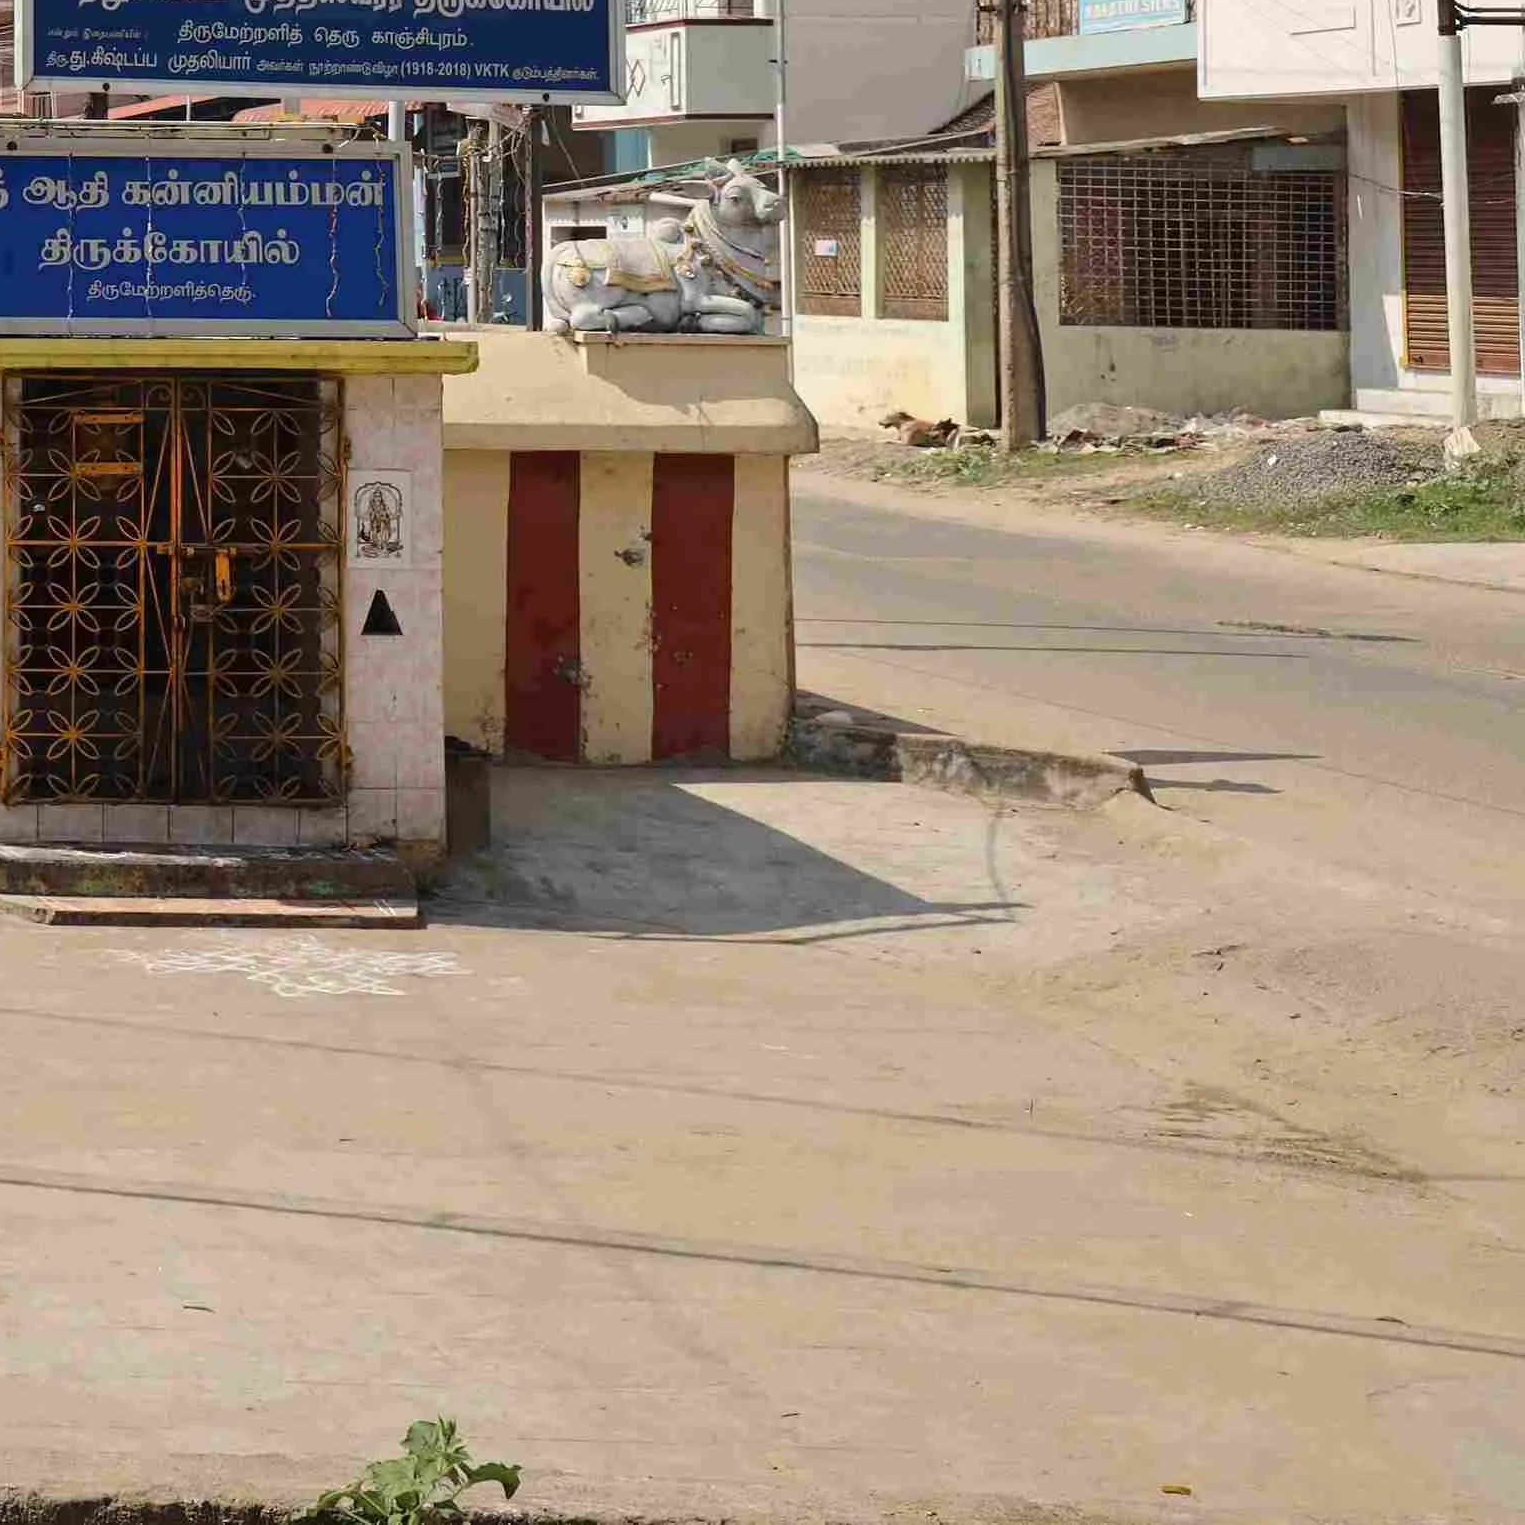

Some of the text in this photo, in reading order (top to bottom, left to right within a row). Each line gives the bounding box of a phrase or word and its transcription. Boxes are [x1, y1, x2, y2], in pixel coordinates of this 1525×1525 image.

[177, 19, 303, 48] திருமேற்றளித்
[314, 25, 360, 48] தெரு
[167, 48, 252, 75] முதலியார்
[400, 60, 471, 79] (1918-2018)
[474, 63, 510, 77] VKTK
[22, 170, 110, 211] ஆதி
[121, 168, 387, 207] கன்னியம்மன்
[38, 226, 300, 270] திருக்கோயில்
